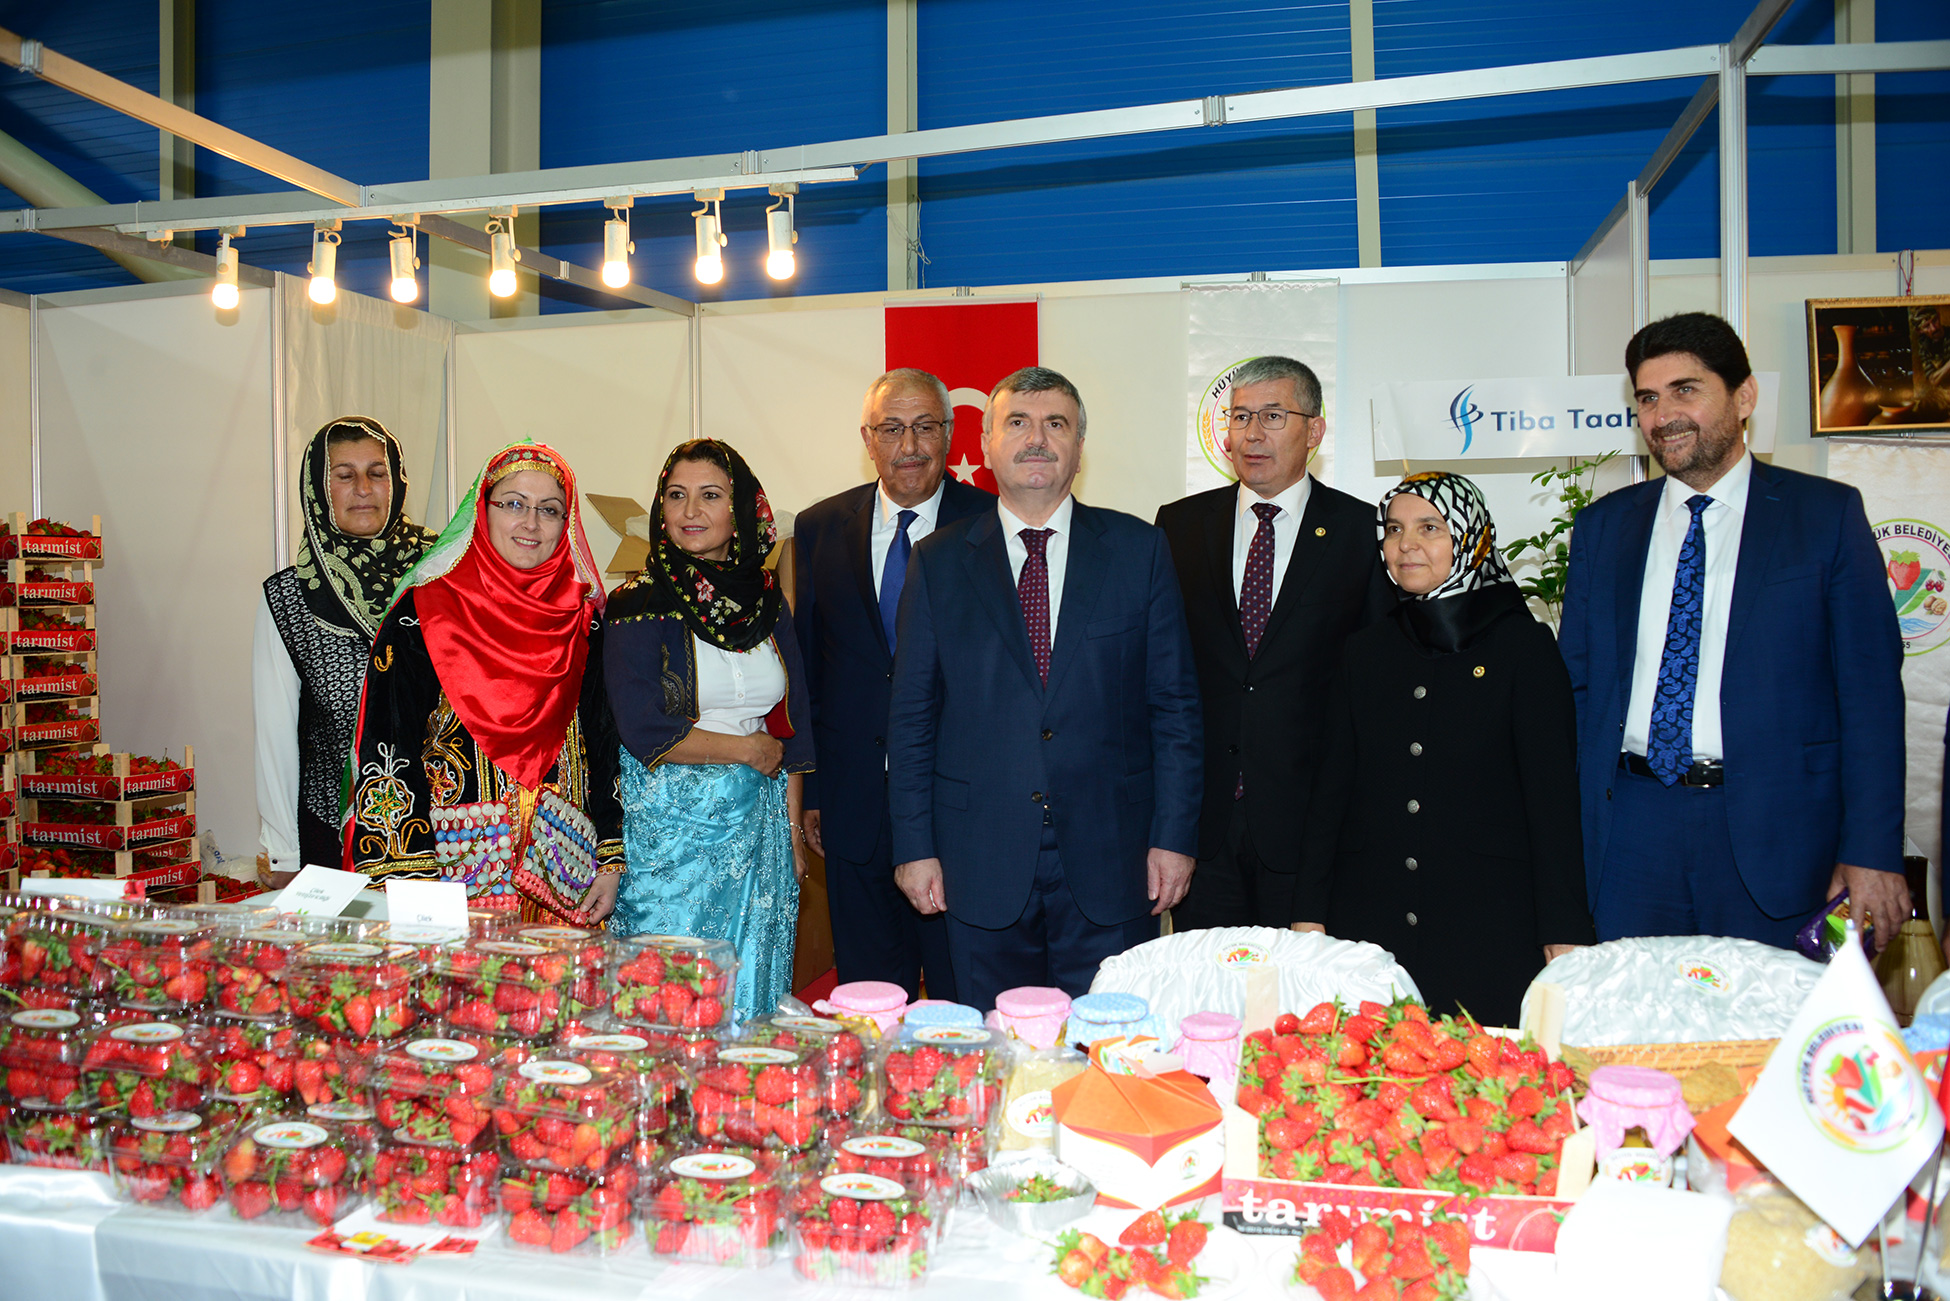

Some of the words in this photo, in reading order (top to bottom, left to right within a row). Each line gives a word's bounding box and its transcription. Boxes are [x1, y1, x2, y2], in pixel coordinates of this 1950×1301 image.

[1490, 409, 1555, 431] Tiba
[25, 539, 82, 555] tarımist
[23, 584, 77, 599] tarımist
[16, 632, 75, 648] tarımist
[20, 677, 78, 695] tarımist
[22, 724, 80, 742] tarımist
[29, 778, 99, 795] tarımist
[126, 774, 177, 795] tarımist
[32, 827, 102, 845] tarımist
[130, 821, 180, 843] tarımist
[144, 868, 184, 889] rımist
